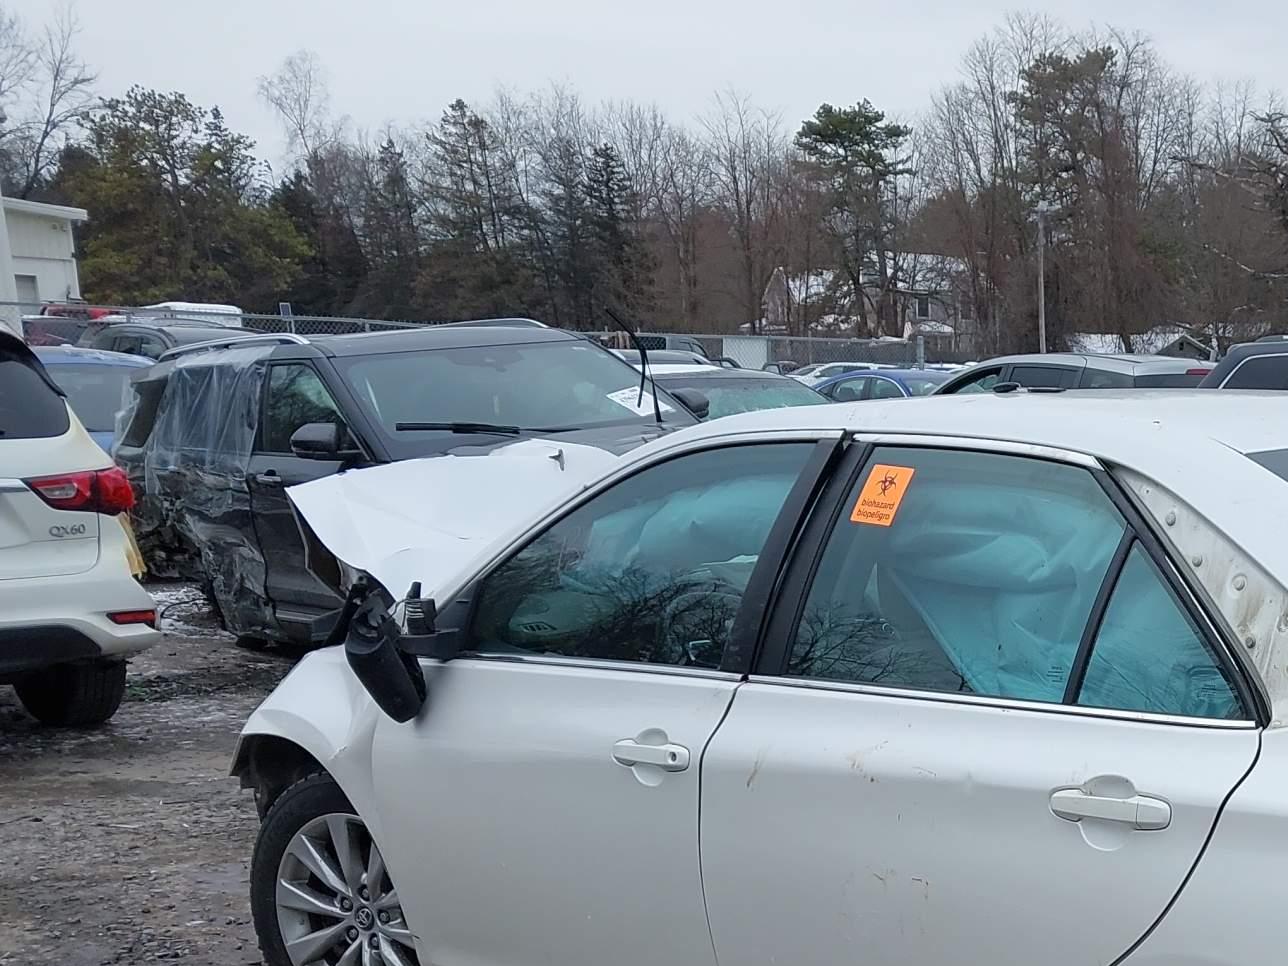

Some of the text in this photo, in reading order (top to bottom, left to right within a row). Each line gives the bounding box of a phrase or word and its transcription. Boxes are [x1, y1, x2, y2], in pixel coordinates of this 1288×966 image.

[861, 499, 895, 510] biohazard
[856, 509, 890, 521] biopeligro
[49, 523, 86, 537] QX60
